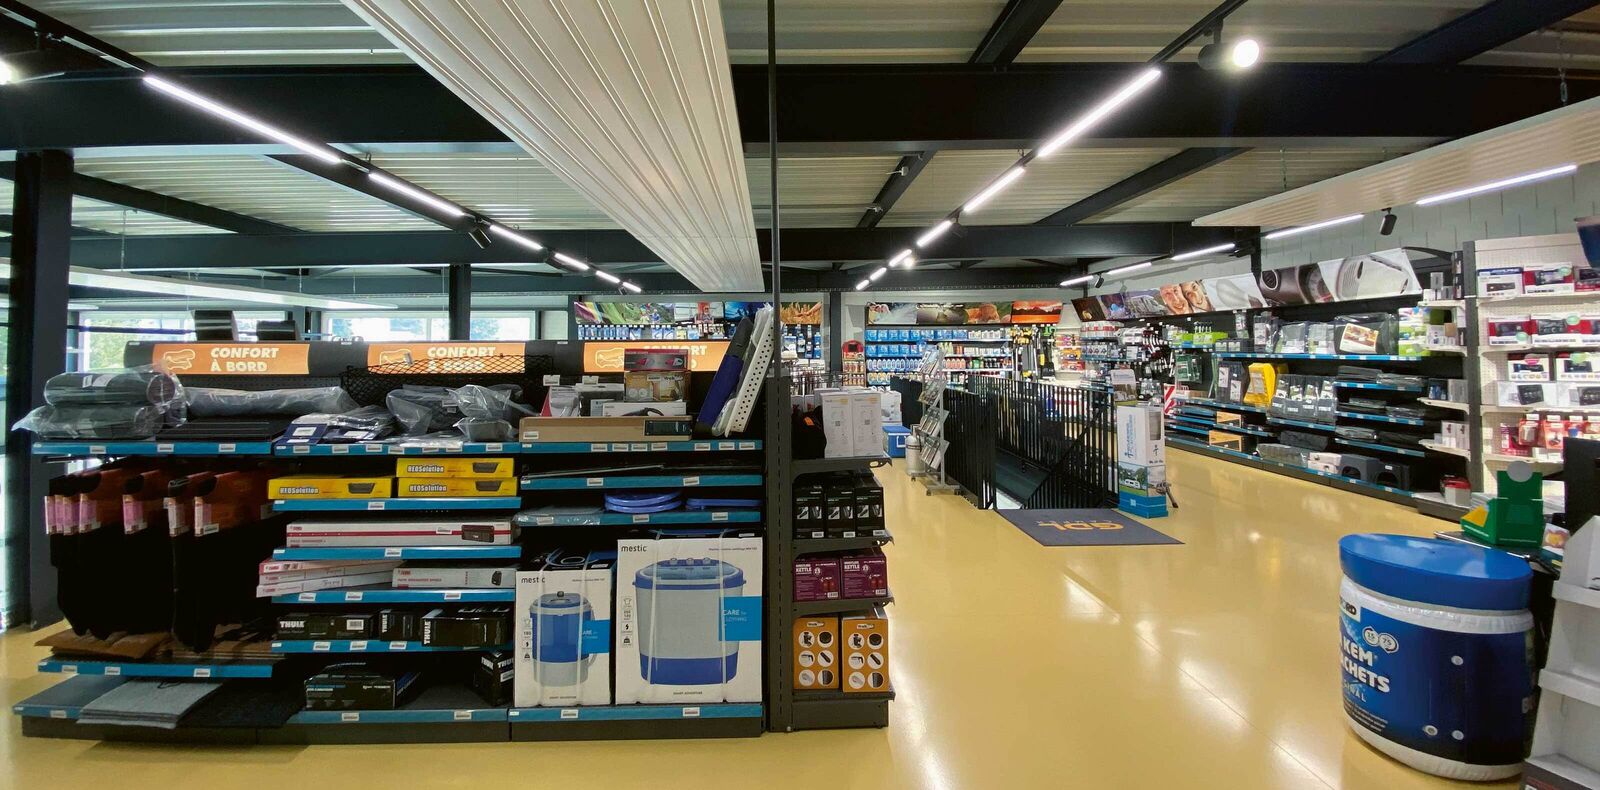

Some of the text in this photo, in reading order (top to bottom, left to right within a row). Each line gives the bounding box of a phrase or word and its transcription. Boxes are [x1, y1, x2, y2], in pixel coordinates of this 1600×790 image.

[210, 347, 280, 359] CONFORT
[427, 346, 496, 358] CONFORT
[210, 359, 268, 372] À BORD
[621, 544, 648, 552] mestic
[521, 576, 546, 584] mestc
[280, 620, 306, 628] THULE
[423, 620, 432, 645] THULE
[1343, 635, 1374, 667] KEM
